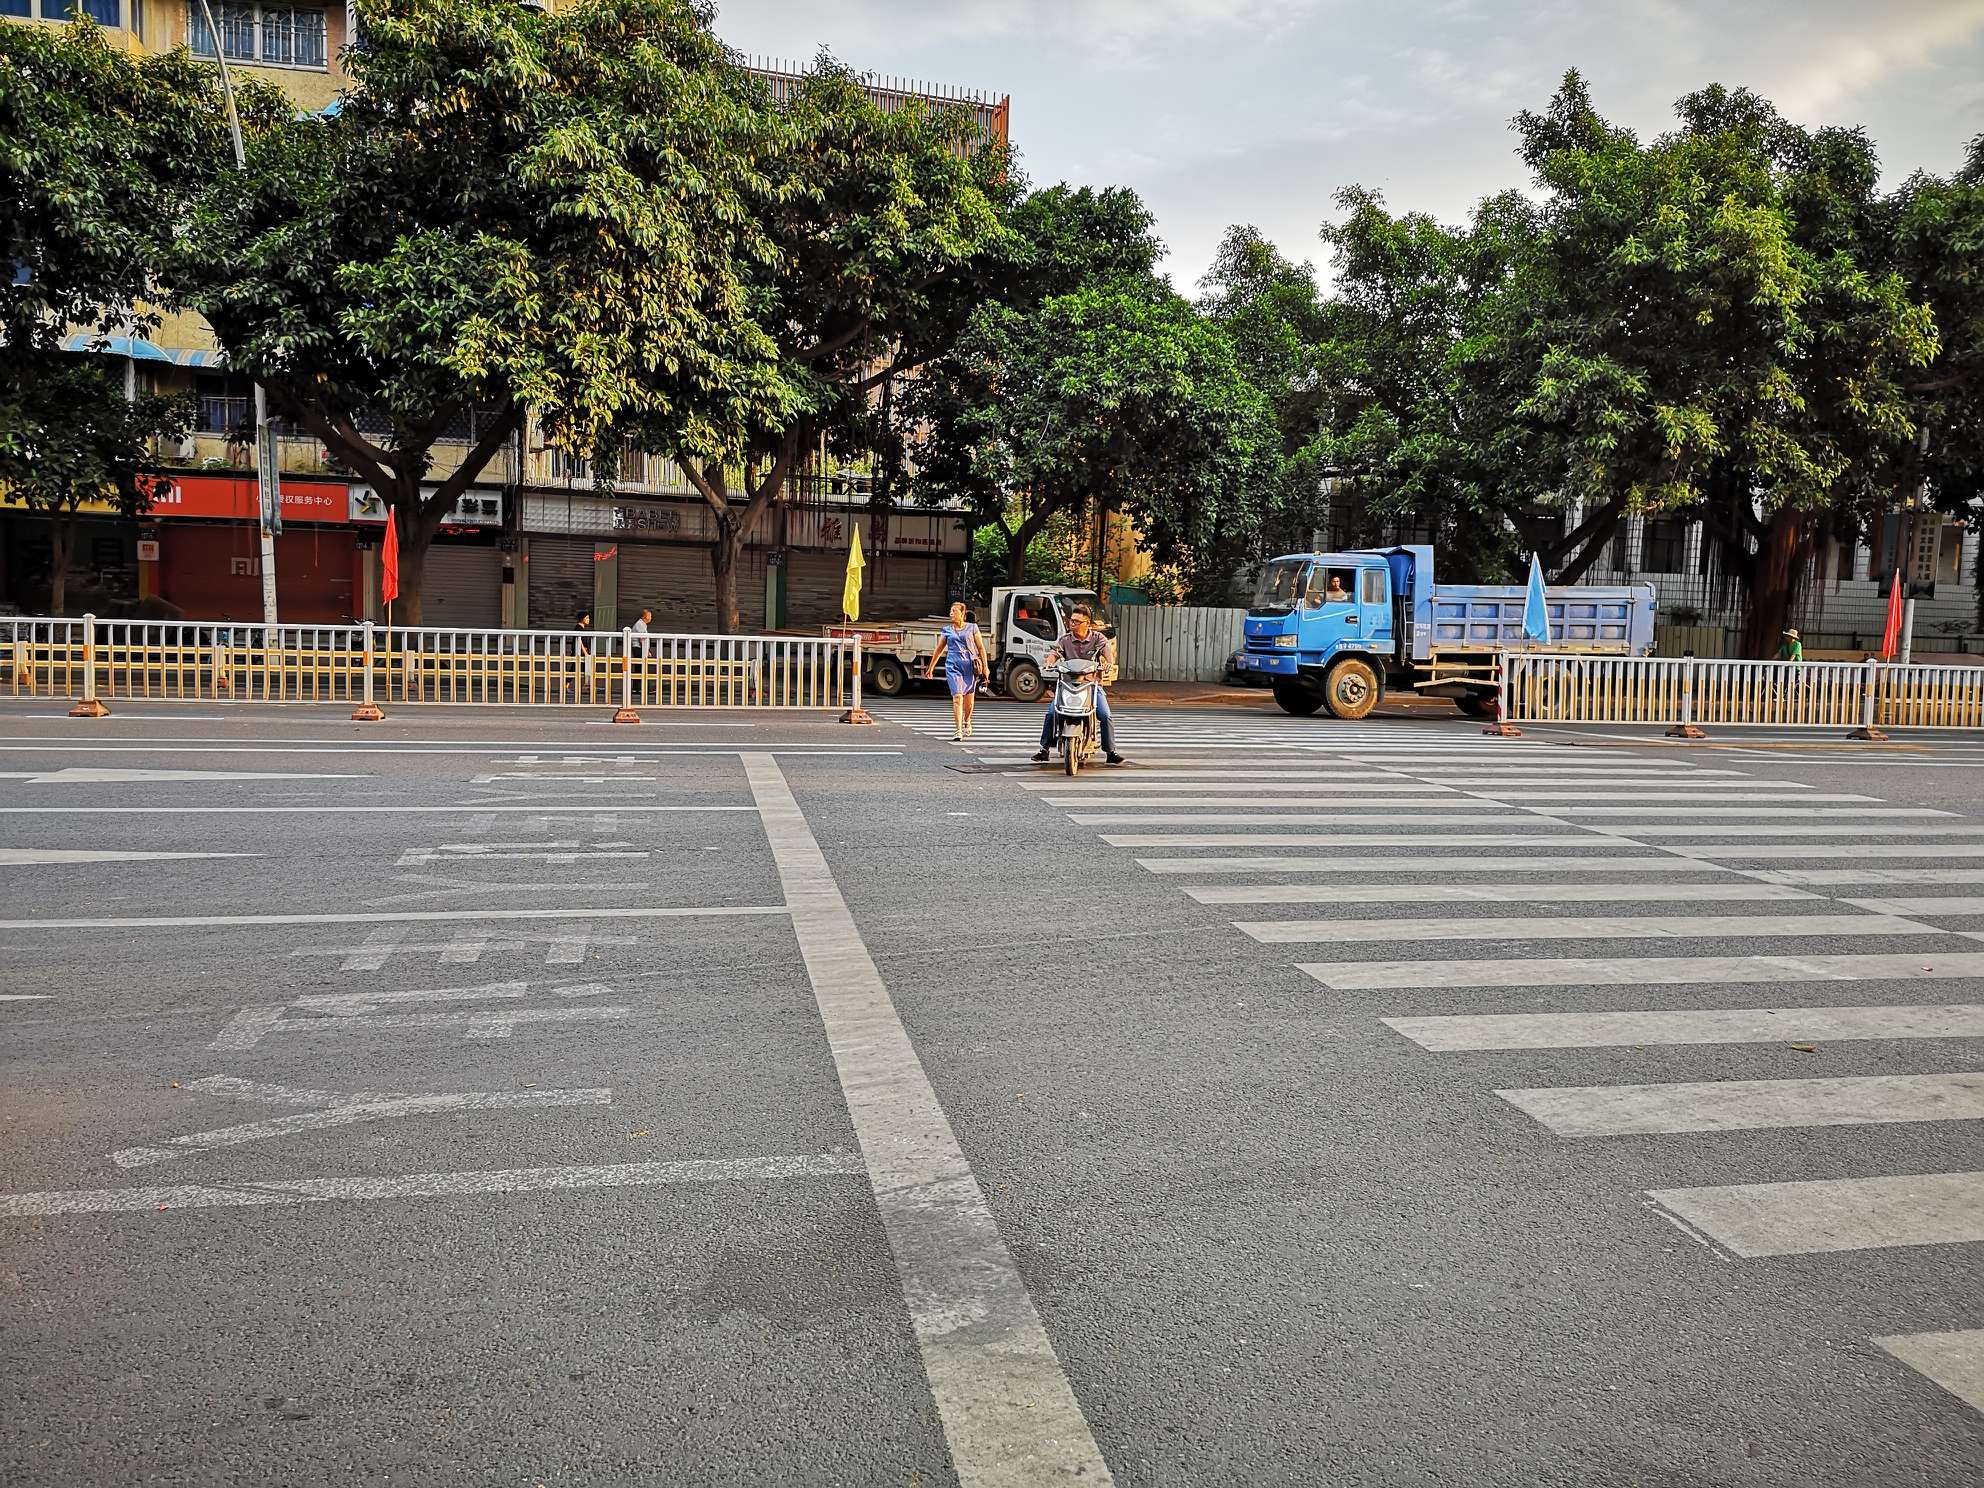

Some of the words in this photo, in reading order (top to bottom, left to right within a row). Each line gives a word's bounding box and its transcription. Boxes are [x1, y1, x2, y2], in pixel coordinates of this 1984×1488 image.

[256, 494, 333, 506] 授权服务中心
